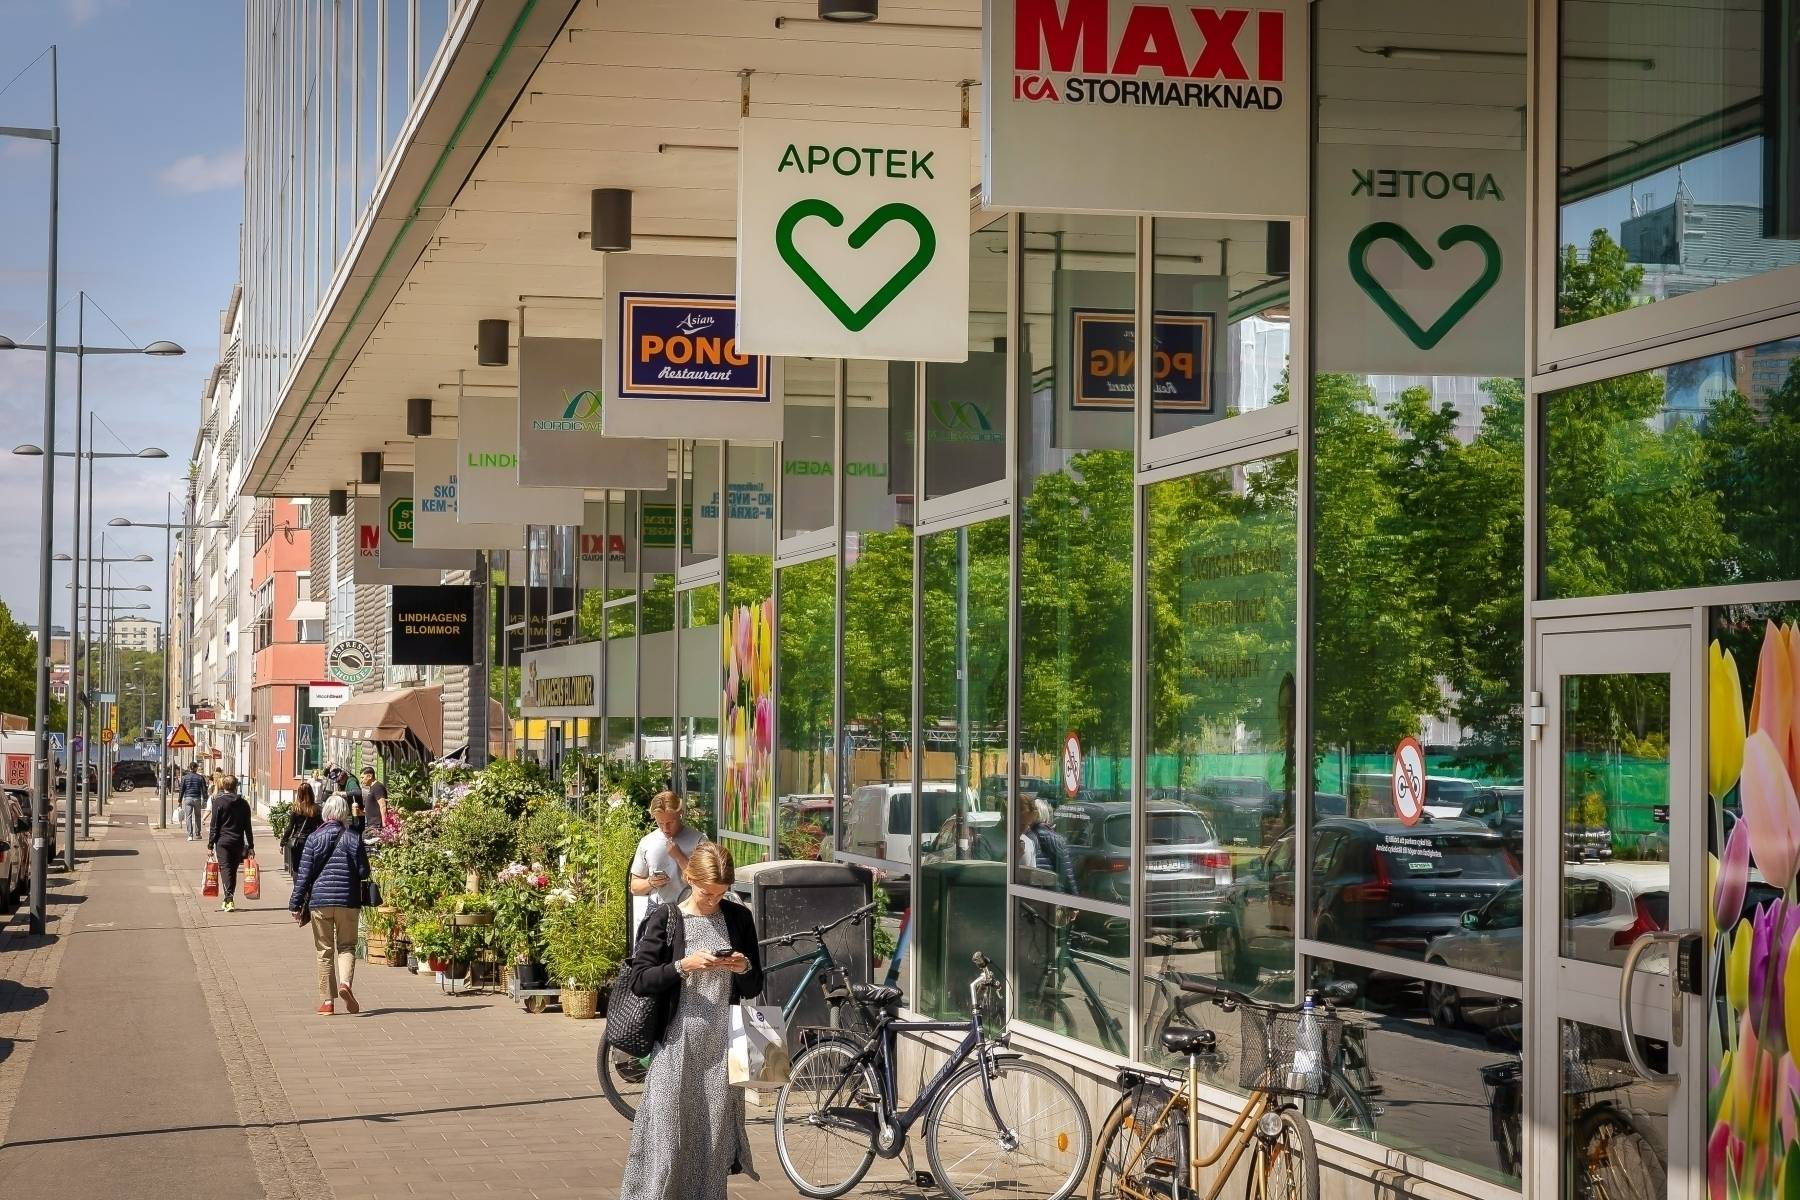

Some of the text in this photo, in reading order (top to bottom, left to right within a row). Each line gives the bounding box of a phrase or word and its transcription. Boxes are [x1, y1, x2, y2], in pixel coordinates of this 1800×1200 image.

[1014, 0, 1285, 81] MAXI
[1014, 75, 1283, 110] ICA STORMARKNAD
[778, 144, 935, 179] APOTEK
[676, 313, 715, 333] Asian
[641, 334, 749, 366] PONG
[658, 366, 731, 382] Restaurant
[398, 613, 467, 623] LINDHAGENS
[405, 625, 460, 635] BLOMMOR
[331, 640, 371, 658] ESPRESSO
[336, 670, 366, 682] HOUSE
[102, 731, 112, 739] 30
